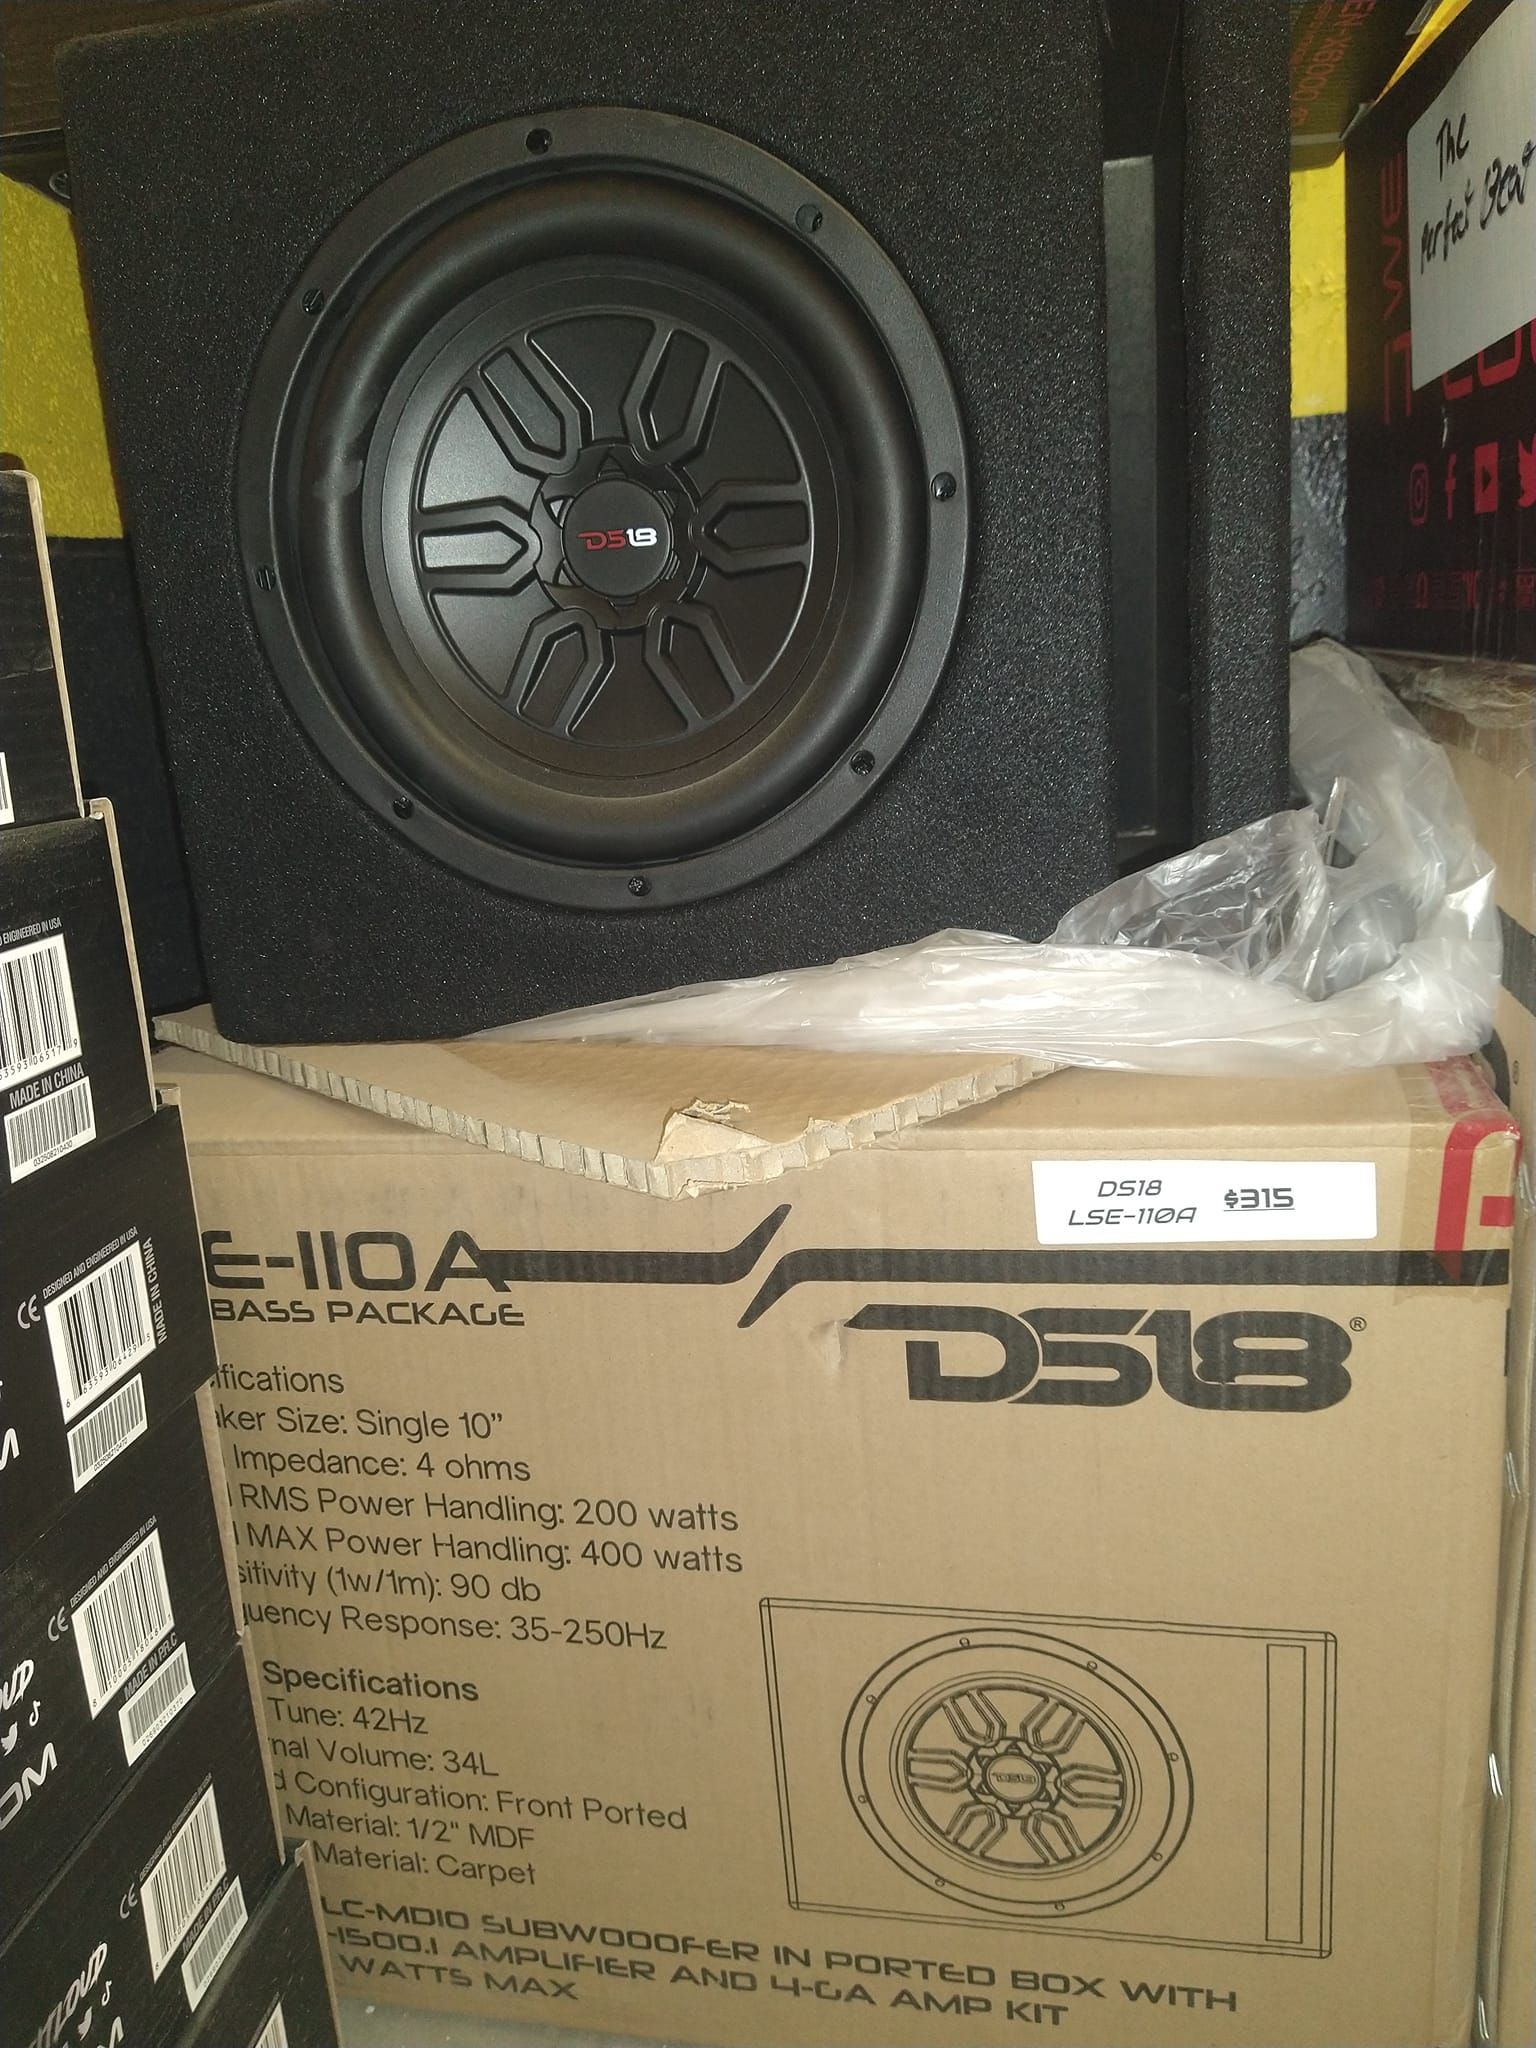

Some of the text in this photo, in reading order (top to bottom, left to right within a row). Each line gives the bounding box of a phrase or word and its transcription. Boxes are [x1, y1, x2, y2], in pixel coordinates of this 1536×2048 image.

[1436, 112, 1470, 182] The
[577, 527, 658, 552] DS18
[2, 916, 62, 945] ENGINEERED IN USA
[9, 1061, 85, 1110] MADE IN CHINA
[1097, 1179, 1163, 1198] DS18
[1223, 1187, 1295, 1212] $315
[1068, 1206, 1198, 1227] LSE-110A
[42, 1270, 73, 1300] DESIGNED
[73, 1260, 87, 1279] AND
[85, 1236, 121, 1271] ENGINEERED
[125, 1224, 140, 1242] USA
[142, 1236, 169, 1345] MADE IN CHINA
[210, 1299, 526, 1326] BASS PACKAGE
[276, 1406, 349, 1436] Size:
[356, 1408, 450, 1444] Single
[233, 1443, 532, 1482] Impedance: 4 ohms
[239, 1483, 309, 1512] RMS
[317, 1487, 415, 1519] Power
[424, 1492, 566, 1531] Handling:
[573, 1498, 638, 1528] 200
[648, 1503, 740, 1532] watts
[69, 1574, 98, 1609] DESIGNED
[96, 1562, 109, 1582] AND
[107, 1530, 141, 1569] ENGINEERED
[145, 1514, 158, 1532] USA
[246, 1521, 319, 1552] MAX
[325, 1526, 423, 1558] Power
[433, 1531, 572, 1571] Handling:
[581, 1539, 644, 1569] 400
[654, 1545, 744, 1573] watts
[327, 1565, 443, 1603] (1w/1m):
[450, 1572, 491, 1600] 90
[501, 1575, 542, 1603] db
[341, 1604, 502, 1641] Response:
[510, 1615, 668, 1651] 35-250Hz
[123, 1665, 148, 1701] MADE
[147, 1651, 159, 1674] IN
[262, 1659, 480, 1702] Specifications
[267, 1696, 429, 1736] Tune: 42Hz
[317, 1737, 435, 1772] Volume:
[442, 1748, 500, 1778] 34L
[294, 1770, 490, 1813] Configuration:
[495, 1790, 573, 1821] Front
[582, 1797, 688, 1831] Ported
[285, 1802, 536, 1850] Material: 1/2" MDF
[312, 1839, 537, 1888] Material: Carpet
[182, 1919, 205, 1956] MADE
[337, 1952, 579, 2000] WATTS MAX
[451, 1940, 656, 1981] AMPLIFIER
[669, 1964, 758, 1992] AND
[769, 1974, 877, 2006] 4-GA
[889, 1988, 993, 2016] AMP
[1006, 1999, 1069, 2026] KIT
[773, 1945, 811, 1968] IN
[824, 1950, 996, 1987] PORTED
[1010, 1969, 1107, 1999] BOX
[1119, 1979, 1237, 2013] WITH
